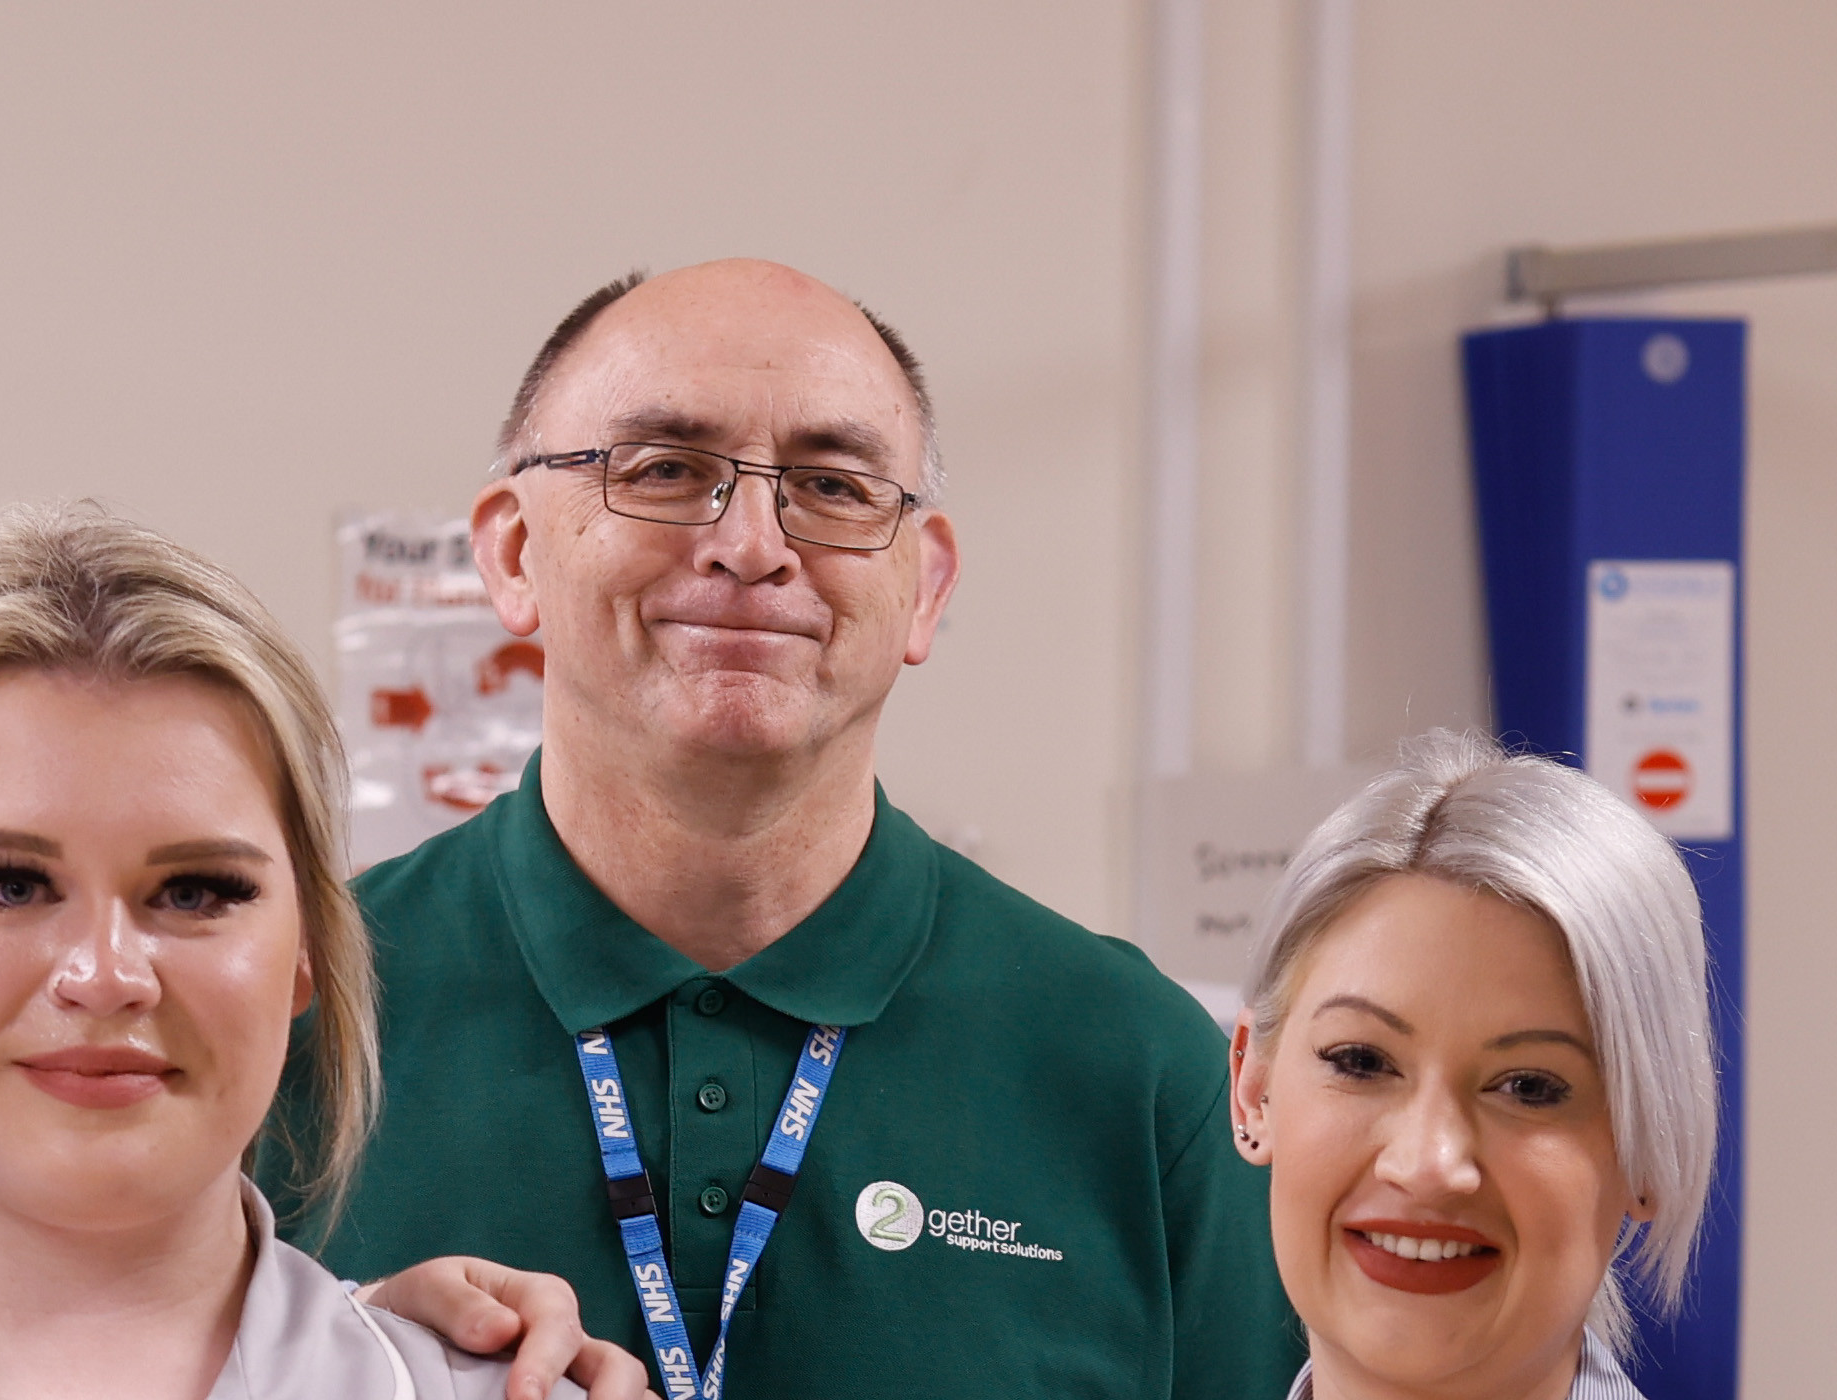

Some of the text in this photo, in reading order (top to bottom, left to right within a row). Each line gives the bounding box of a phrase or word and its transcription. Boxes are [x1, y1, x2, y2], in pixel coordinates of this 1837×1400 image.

[809, 1025, 841, 1066] HS
[591, 1078, 630, 1139] NHS
[780, 1077, 820, 1141] NHS
[634, 1262, 676, 1323] NHS
[721, 1258, 750, 1320] NHS
